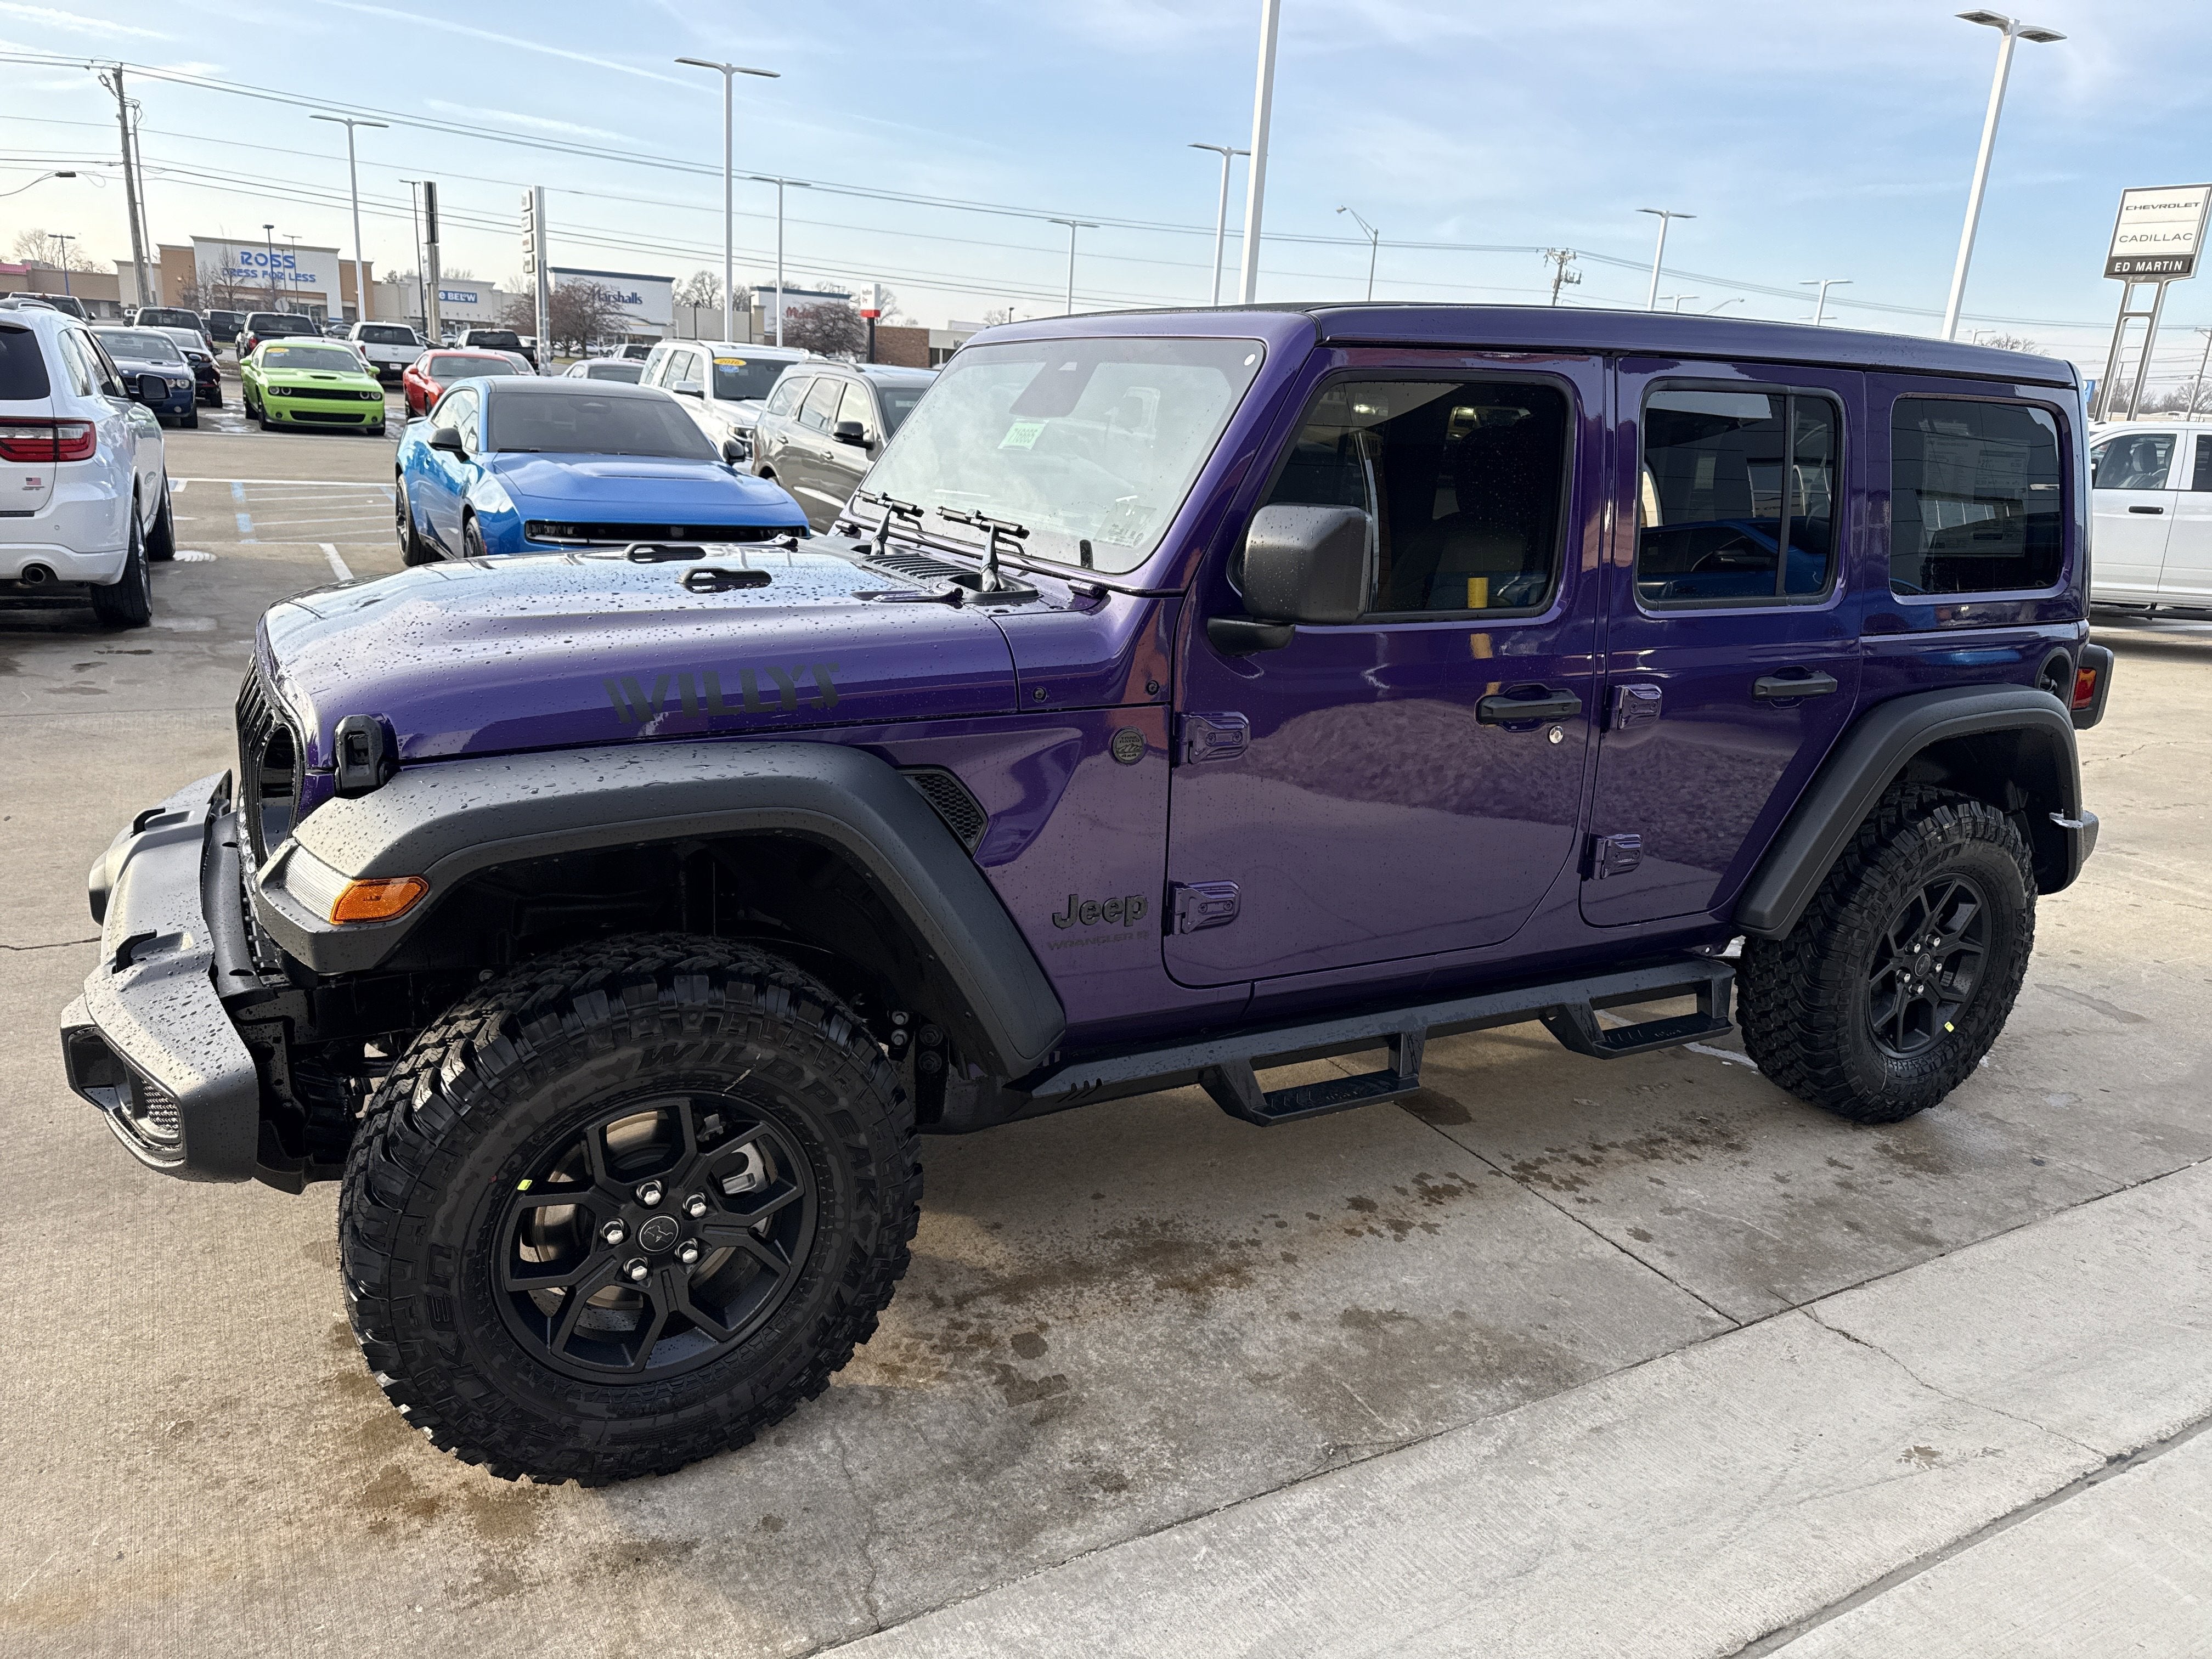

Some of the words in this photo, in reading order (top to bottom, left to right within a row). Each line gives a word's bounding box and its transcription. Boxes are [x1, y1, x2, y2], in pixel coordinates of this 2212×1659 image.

[2125, 201, 2201, 211] CHEVROLET
[2119, 232, 2193, 243] CADILLAC
[240, 251, 295, 269] ROSS
[2114, 262, 2131, 272] ED
[2135, 260, 2183, 272] MARTIN
[222, 267, 258, 278] DRESS
[262, 270, 285, 280] FOR
[289, 272, 317, 283] LESS
[448, 292, 476, 302] BELOW
[591, 287, 643, 305] Marshalls
[604, 663, 840, 724] WILLYS
[1052, 893, 1148, 929] Jeep
[1047, 933, 1133, 950] WRANGLER
[636, 1041, 879, 1212] WILDPEAK
